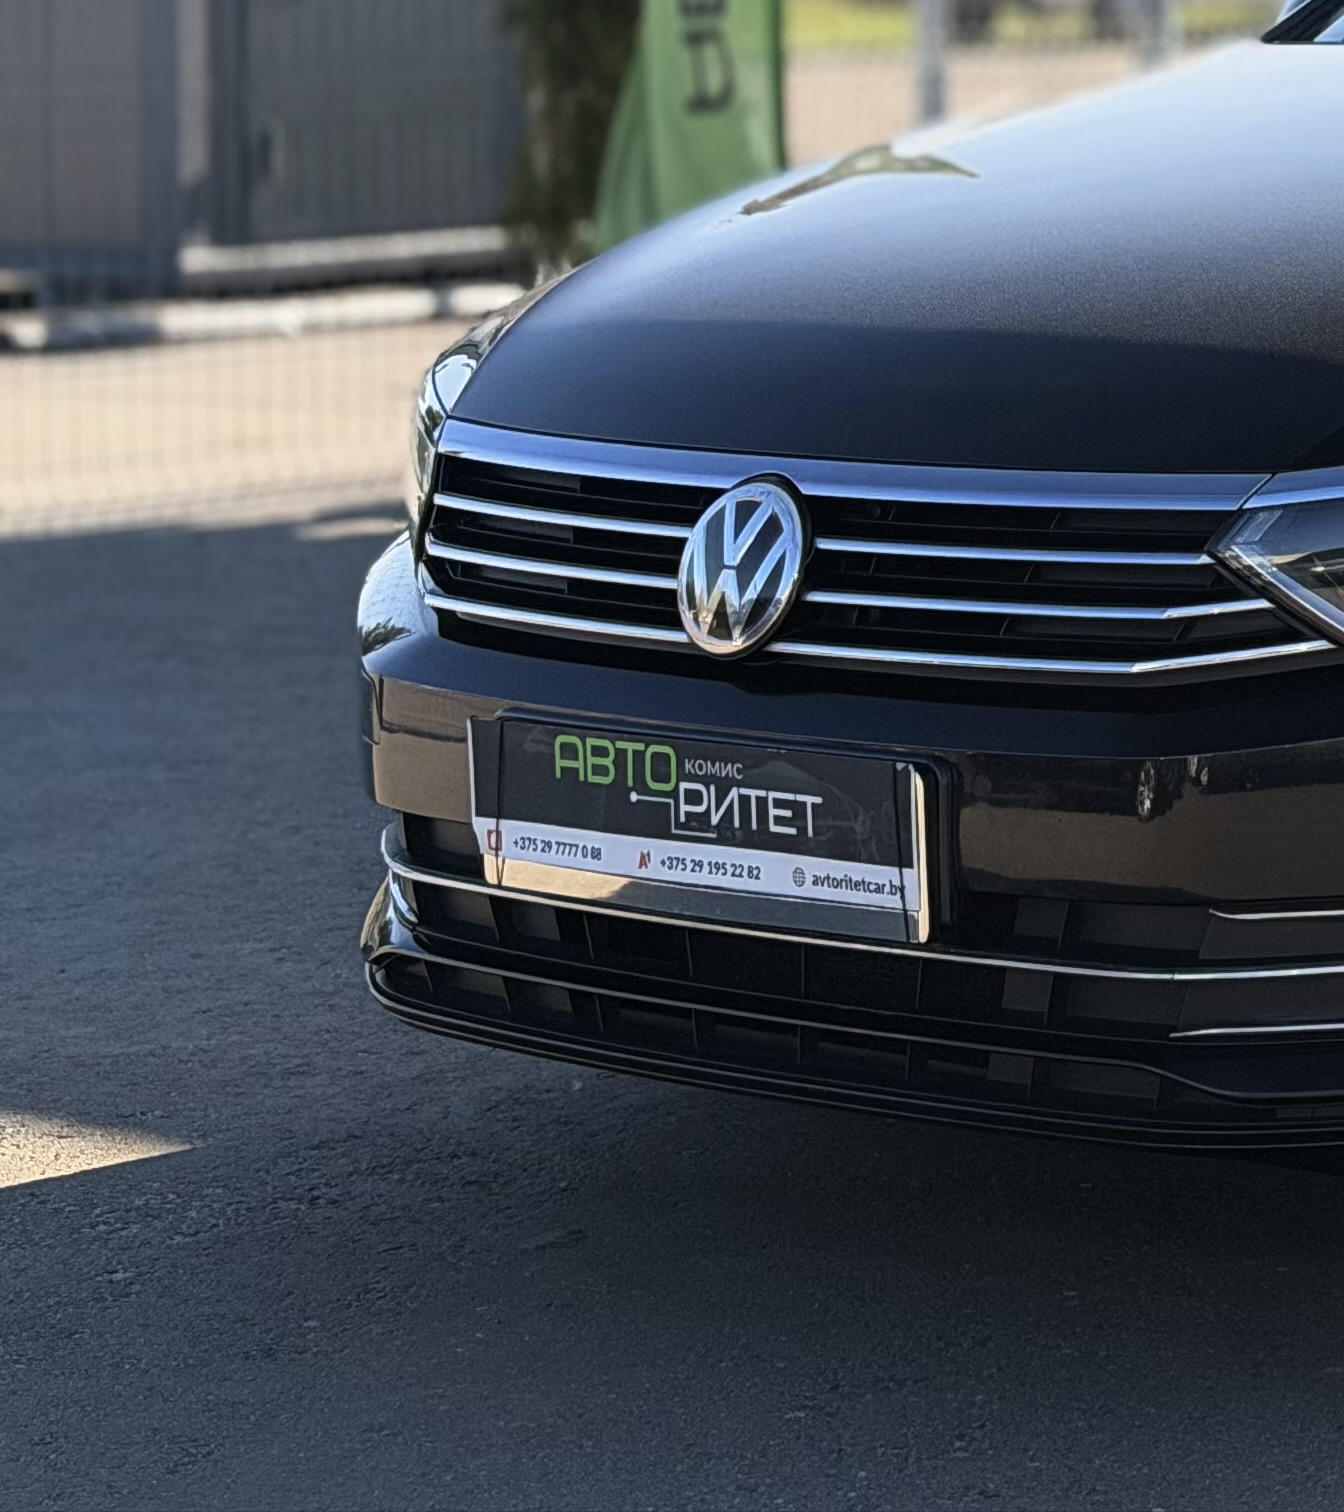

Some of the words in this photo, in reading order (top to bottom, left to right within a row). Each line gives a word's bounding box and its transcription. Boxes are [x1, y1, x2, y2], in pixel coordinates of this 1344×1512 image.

[554, 734, 677, 792] АВТО
[679, 781, 823, 838] РИТЕТ
[513, 835, 539, 853] +375
[540, 839, 553, 854] 29
[554, 840, 579, 858] 7777
[660, 855, 688, 872] +375
[690, 858, 704, 873] 29
[707, 861, 728, 876] 195
[730, 863, 745, 878] 22
[811, 873, 906, 899] avtoritetcar.by
